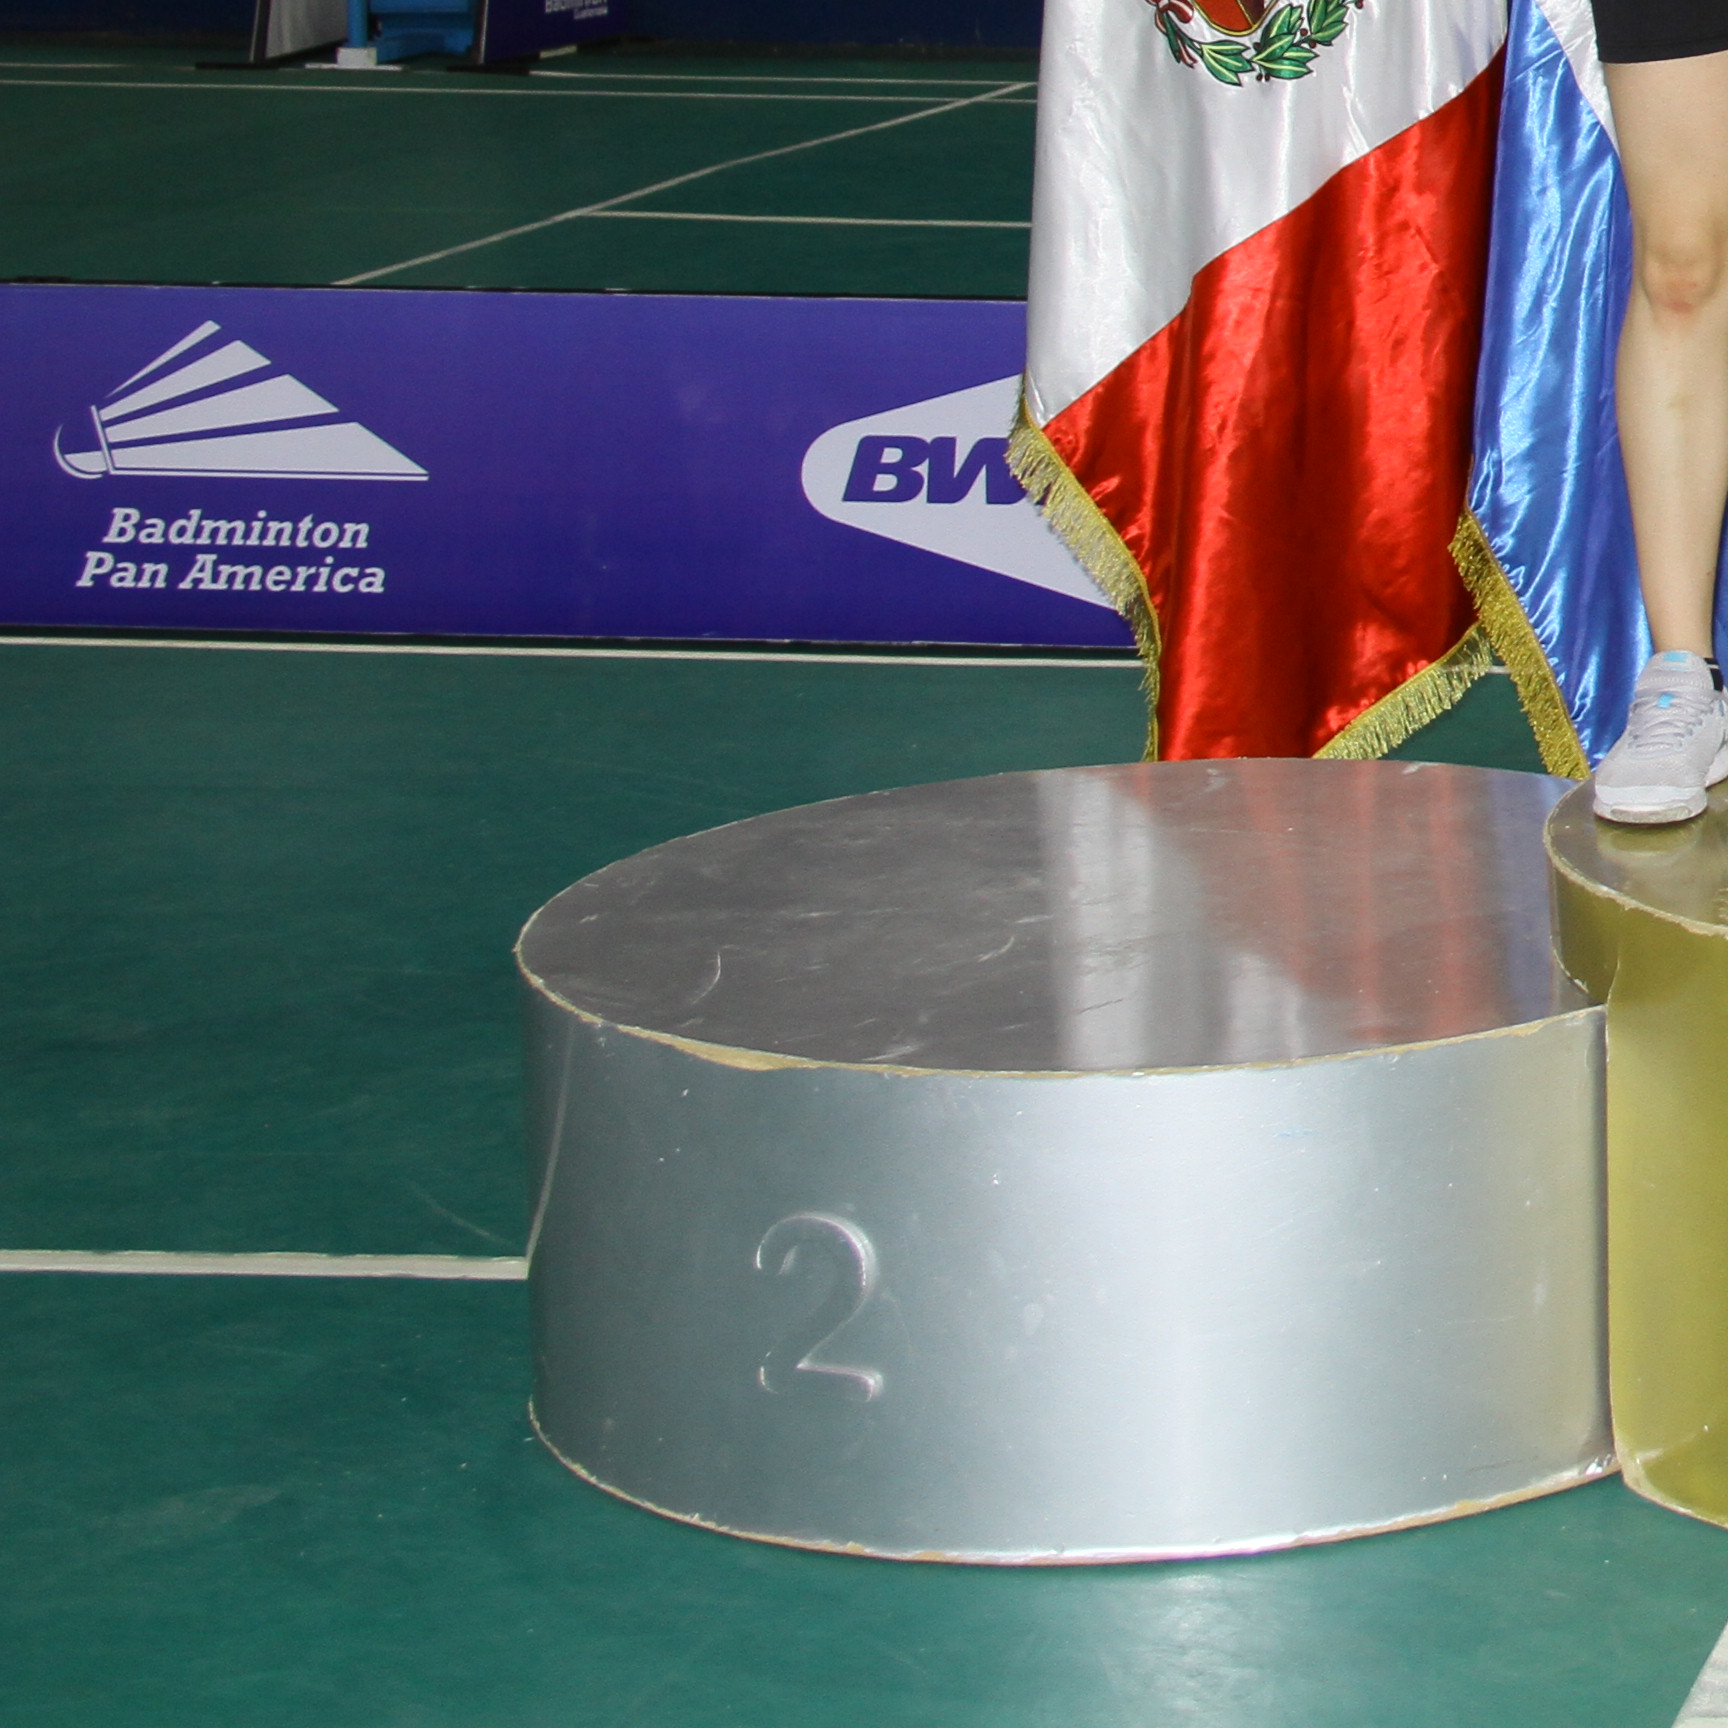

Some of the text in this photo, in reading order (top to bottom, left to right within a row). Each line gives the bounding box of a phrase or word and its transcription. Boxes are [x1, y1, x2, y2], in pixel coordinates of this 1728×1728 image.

[843, 435, 1048, 505] BW
[103, 508, 369, 548] Badminton
[75, 551, 386, 593] Pan America
[756, 1211, 883, 1402] 2
